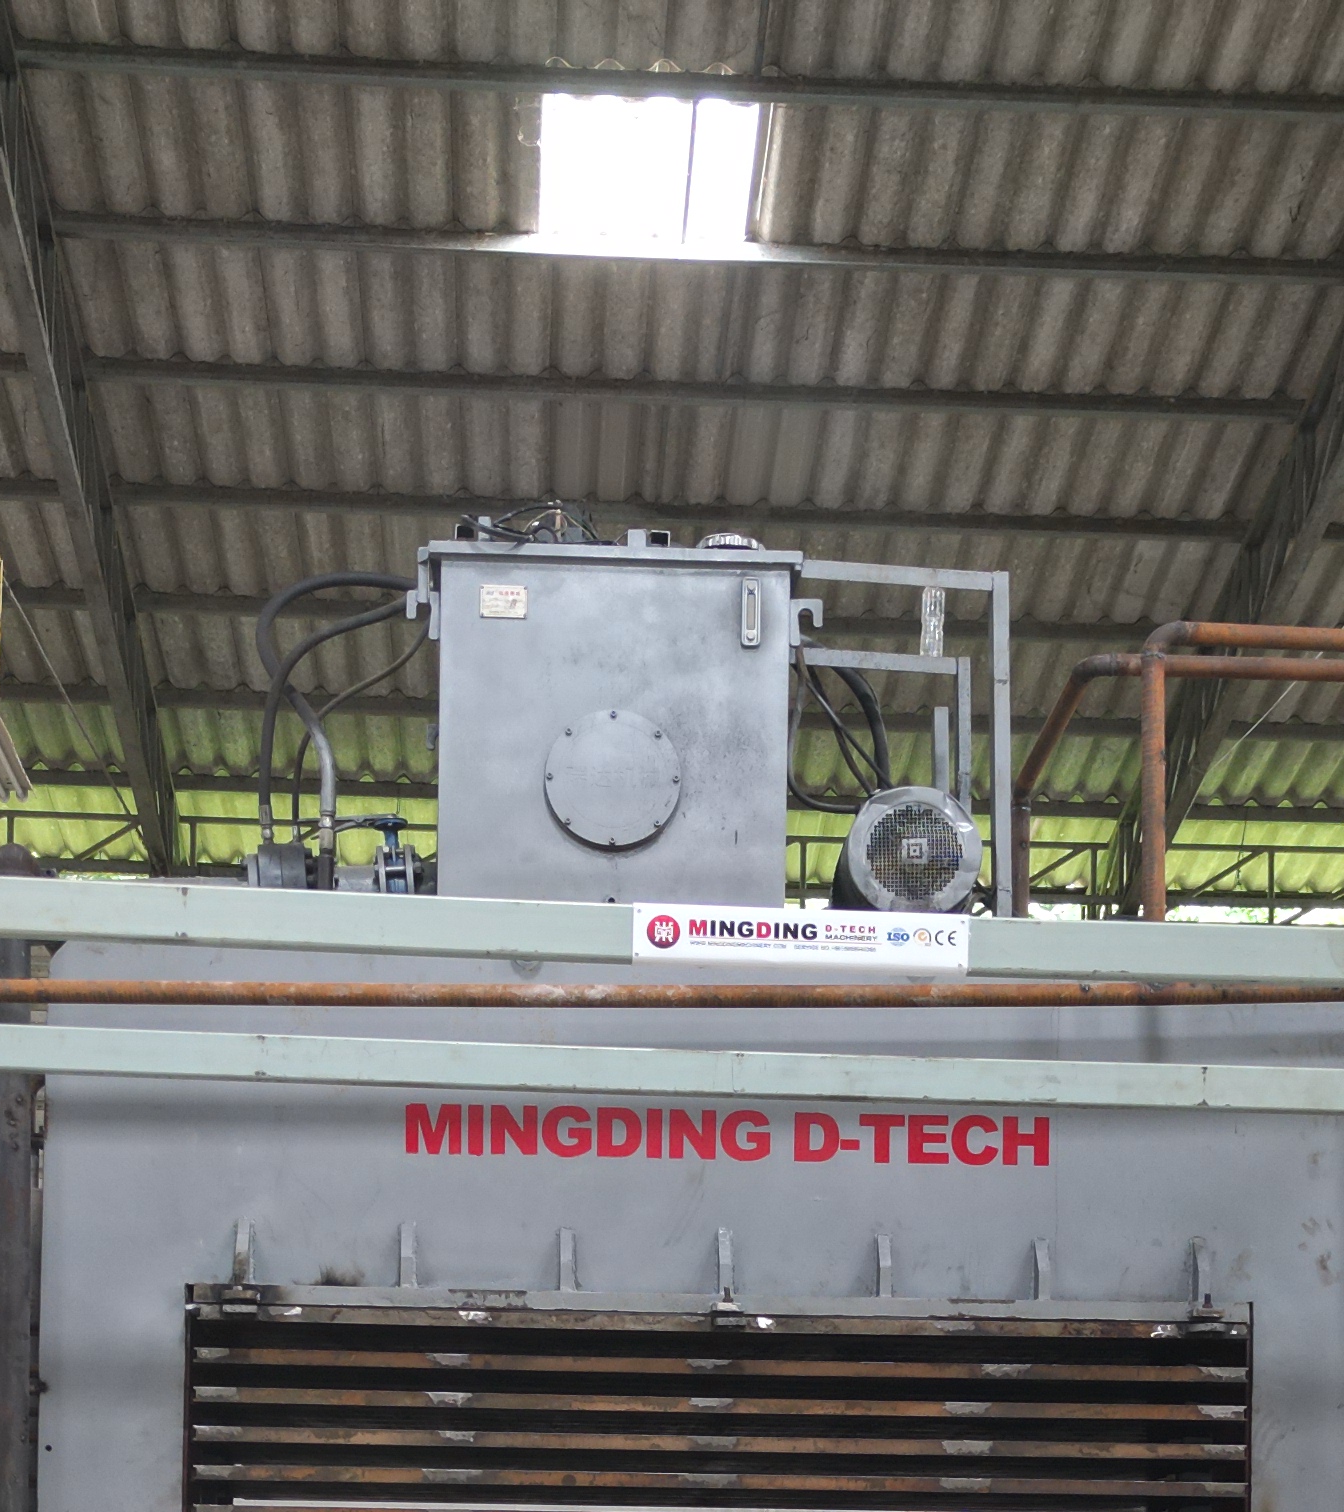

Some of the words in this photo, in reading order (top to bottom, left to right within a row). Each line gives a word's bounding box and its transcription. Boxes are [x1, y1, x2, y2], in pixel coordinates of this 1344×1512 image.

[688, 918, 818, 941] MINGDING
[824, 924, 877, 935] D-TECH
[405, 1103, 772, 1162] MINGDING
[793, 1112, 1050, 1167] D-TECH
